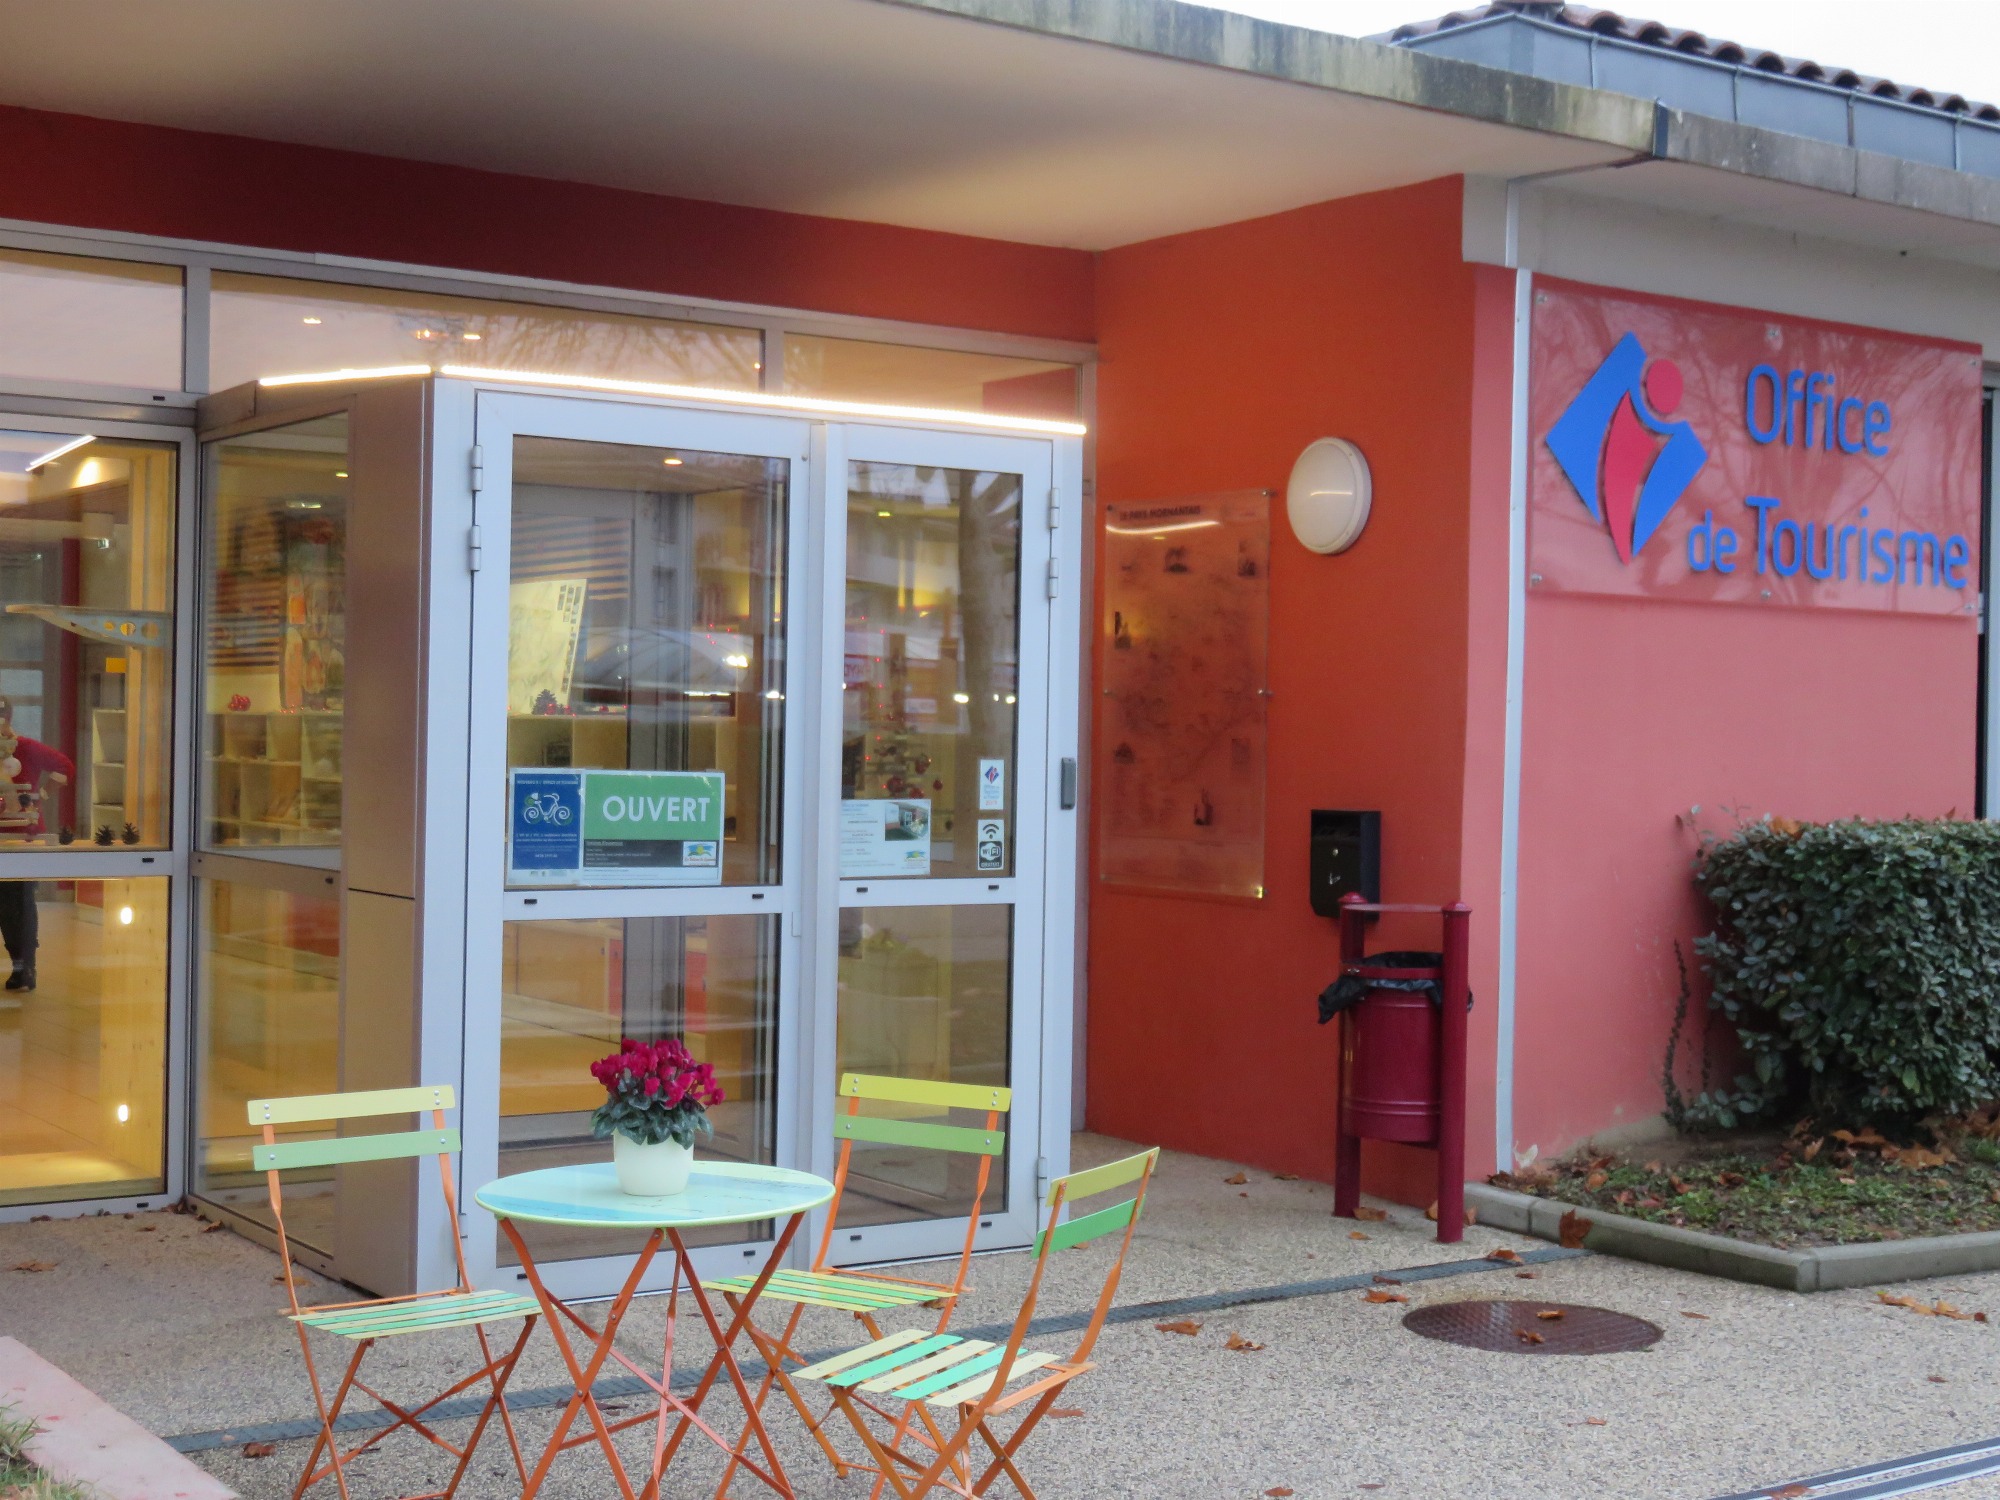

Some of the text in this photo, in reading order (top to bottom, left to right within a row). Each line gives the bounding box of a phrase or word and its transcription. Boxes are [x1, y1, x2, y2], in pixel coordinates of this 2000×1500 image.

[1746, 364, 1892, 457] Office
[1687, 495, 1969, 589] de Tourisme
[602, 794, 711, 823] OUVERT
